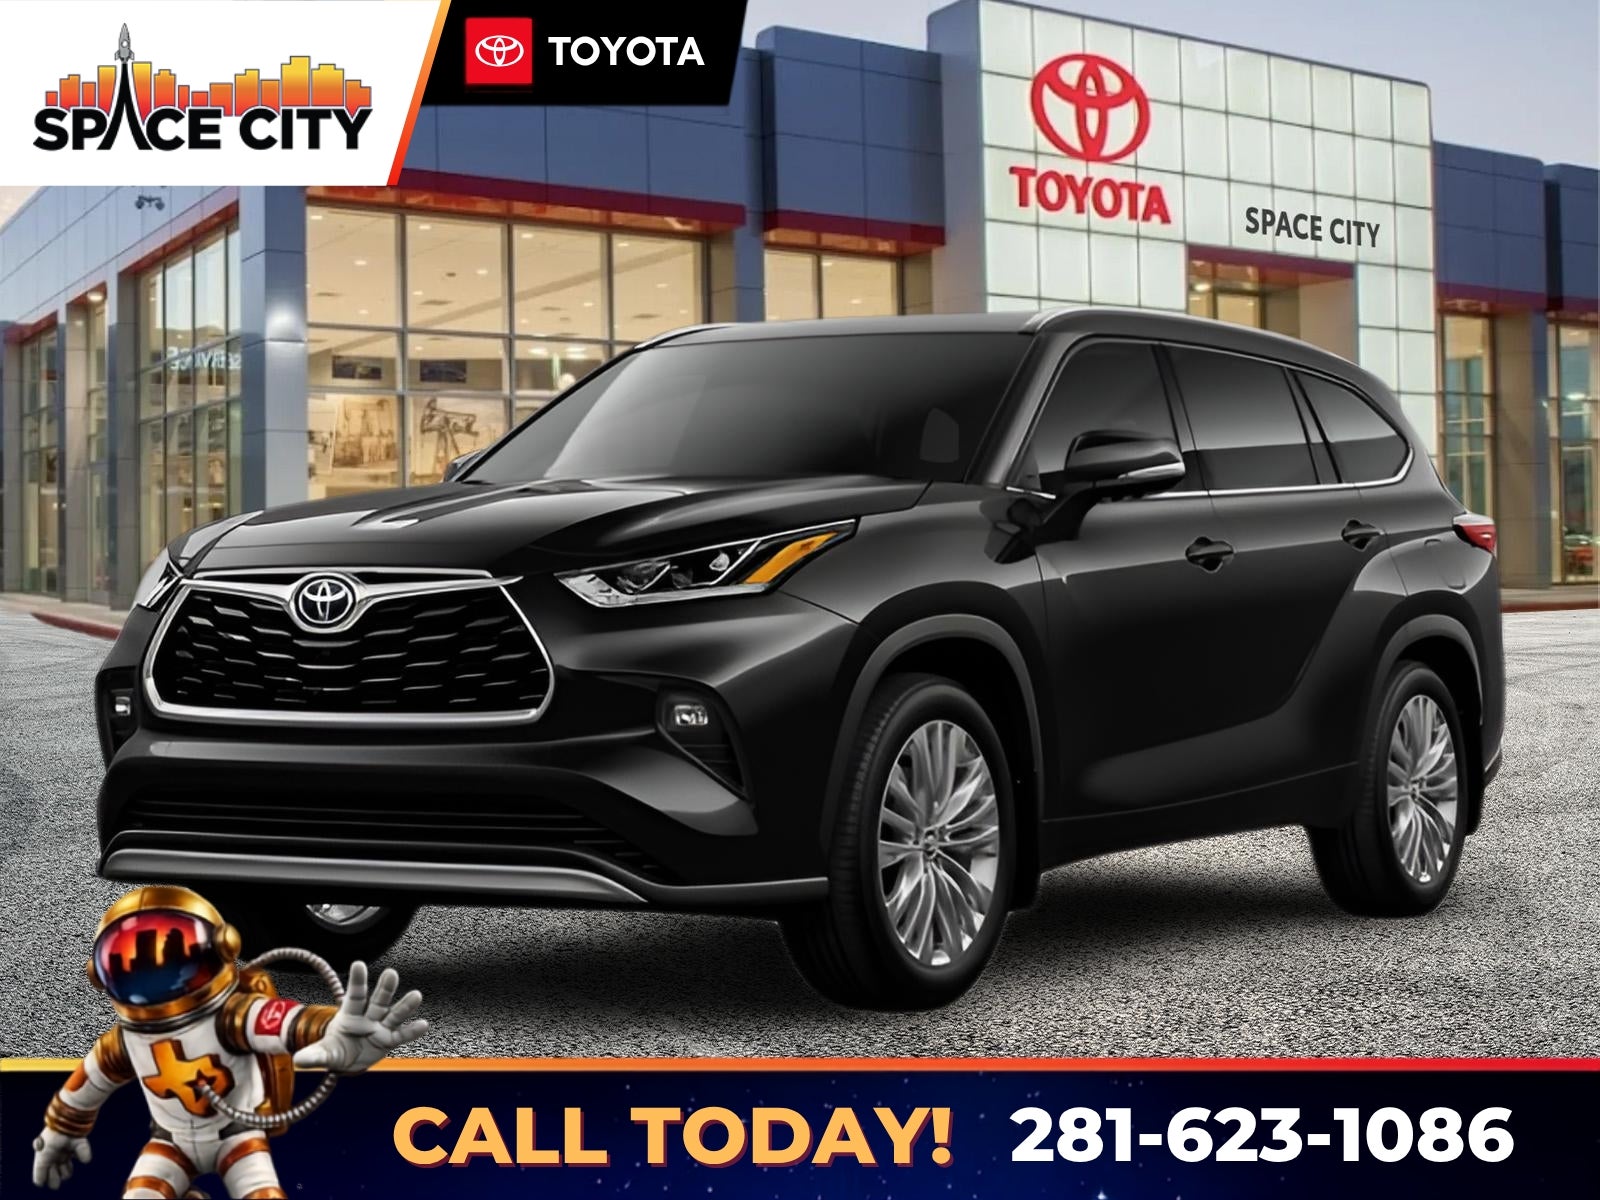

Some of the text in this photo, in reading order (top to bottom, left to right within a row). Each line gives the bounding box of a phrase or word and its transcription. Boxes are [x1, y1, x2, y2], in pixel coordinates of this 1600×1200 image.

[1009, 166, 1171, 224] TOYOTA
[1245, 206, 1381, 249] SPACE CITY
